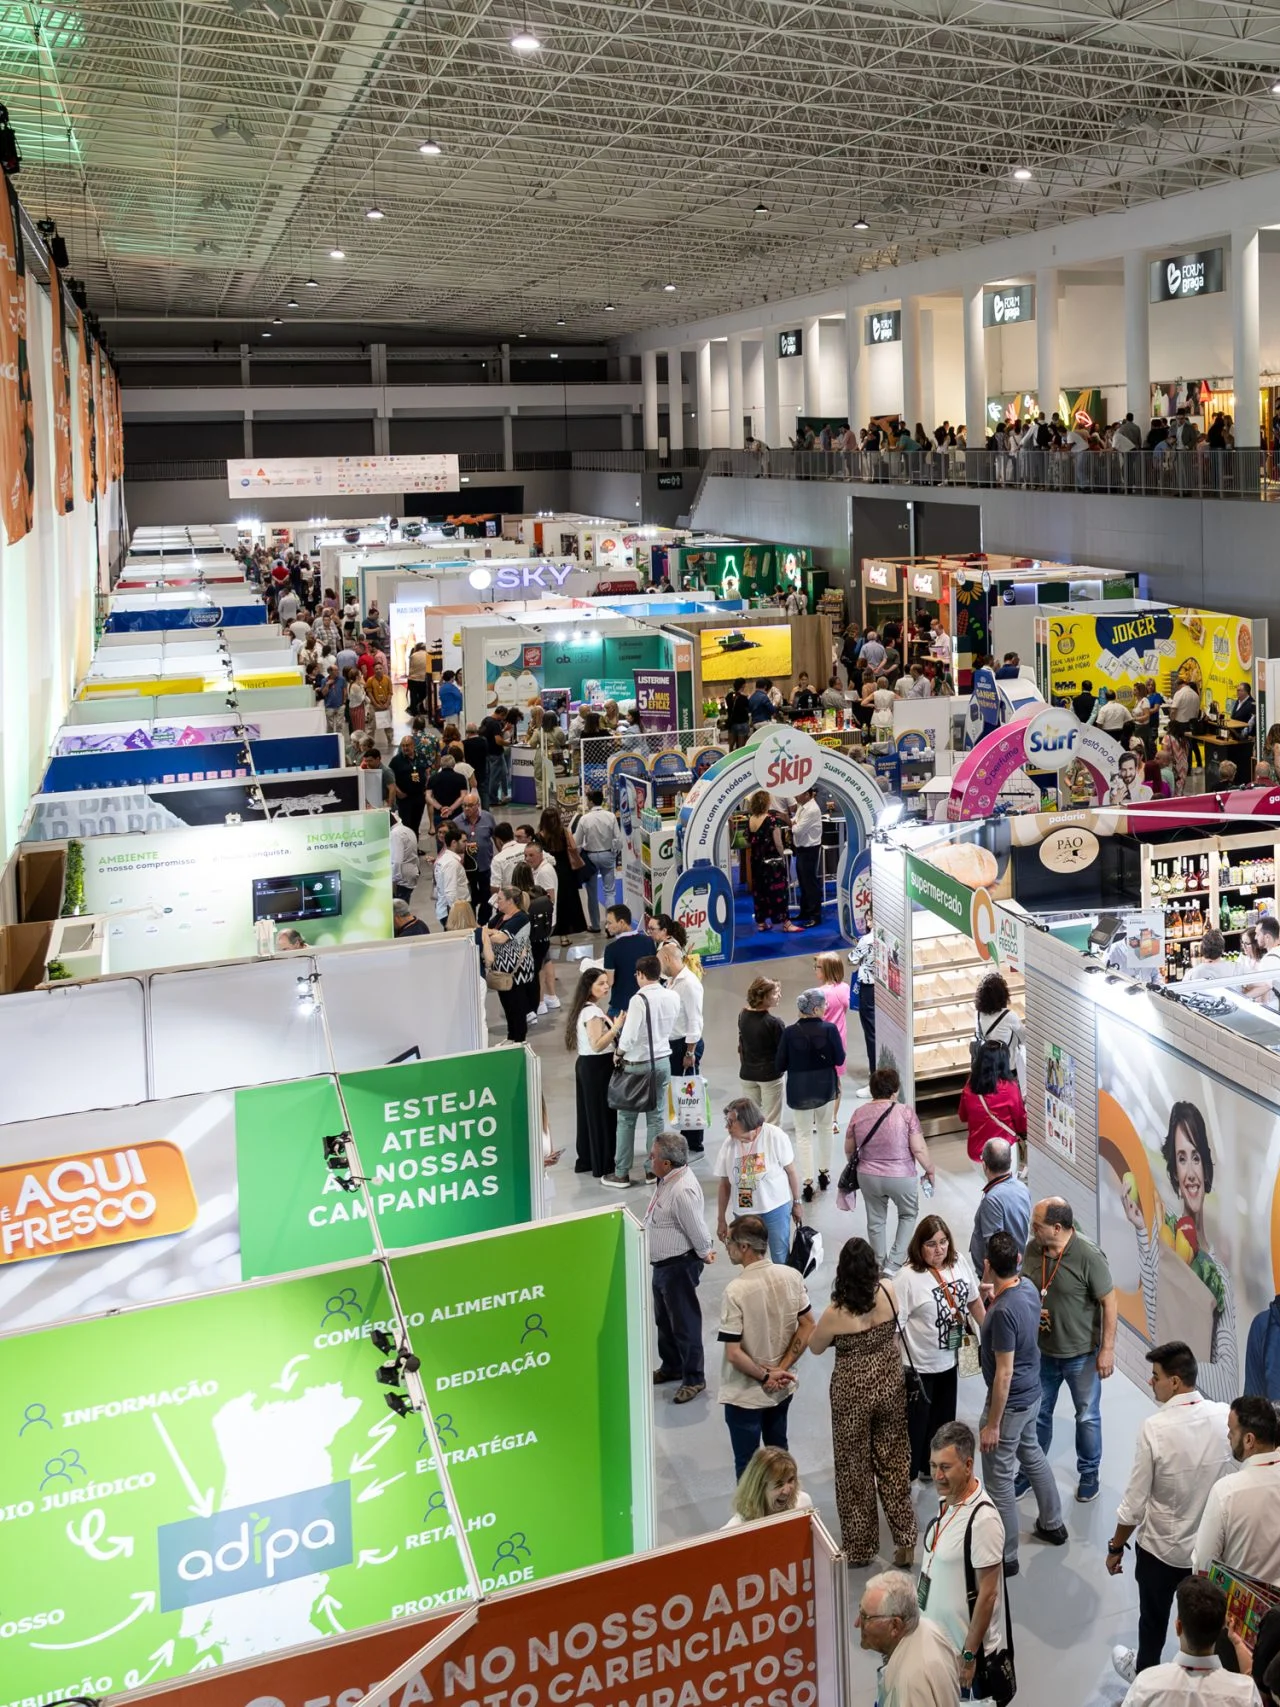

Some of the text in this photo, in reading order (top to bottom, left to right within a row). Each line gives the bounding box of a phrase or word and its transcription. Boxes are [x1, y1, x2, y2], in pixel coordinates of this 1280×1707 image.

[1182, 262, 1204, 279] FORUM
[1182, 276, 1204, 293] Braga
[496, 565, 573, 589] SKY
[1112, 616, 1157, 645] JOKER
[637, 676, 670, 685] LISTERINE
[638, 690, 648, 710] 5
[1030, 729, 1078, 753] Surf
[1098, 746, 1108, 757] no
[766, 755, 812, 788] Skip
[823, 761, 847, 779] Suave
[845, 774, 862, 794] para
[698, 770, 752, 845] Duro com as nódoas
[1049, 812, 1086, 825] padaria
[307, 829, 366, 844] INOVAÇÃO
[314, 842, 338, 850] nossa
[340, 839, 366, 848] força.
[1057, 836, 1083, 850] PÃO
[98, 851, 159, 865] AMBIENTE
[107, 864, 134, 872] nosso
[136, 858, 196, 871] compromisso
[855, 889, 872, 908] Sk
[910, 868, 963, 917] supermercado
[1000, 917, 1017, 941] AQUI
[998, 936, 1019, 956] FRESCO
[384, 1086, 497, 1123] ESTEJA
[381, 1116, 497, 1154] ATENTO
[376, 1146, 499, 1183] NOSSAS
[15, 1149, 148, 1217] AQUI
[308, 1175, 499, 1227] CAMPANHAS
[0, 1190, 157, 1255] É FRESCO
[430, 1284, 546, 1322] ALIMENTAR
[436, 1351, 552, 1392] DEDICAÇÃO
[61, 1379, 219, 1428] INFORMAÇÃO
[415, 1430, 538, 1475] ESTRATÉGIA
[40, 1471, 156, 1513] JURÍDICO
[177, 1511, 335, 1580] adipa
[405, 1512, 497, 1550] RETAHO
[391, 1566, 535, 1619] PROXIMDADE
[443, 1645, 516, 1698] NO
[528, 1592, 693, 1674] NOSSO
[701, 1557, 815, 1622] ADN!
[547, 1599, 816, 1701] CARENCIADO!
